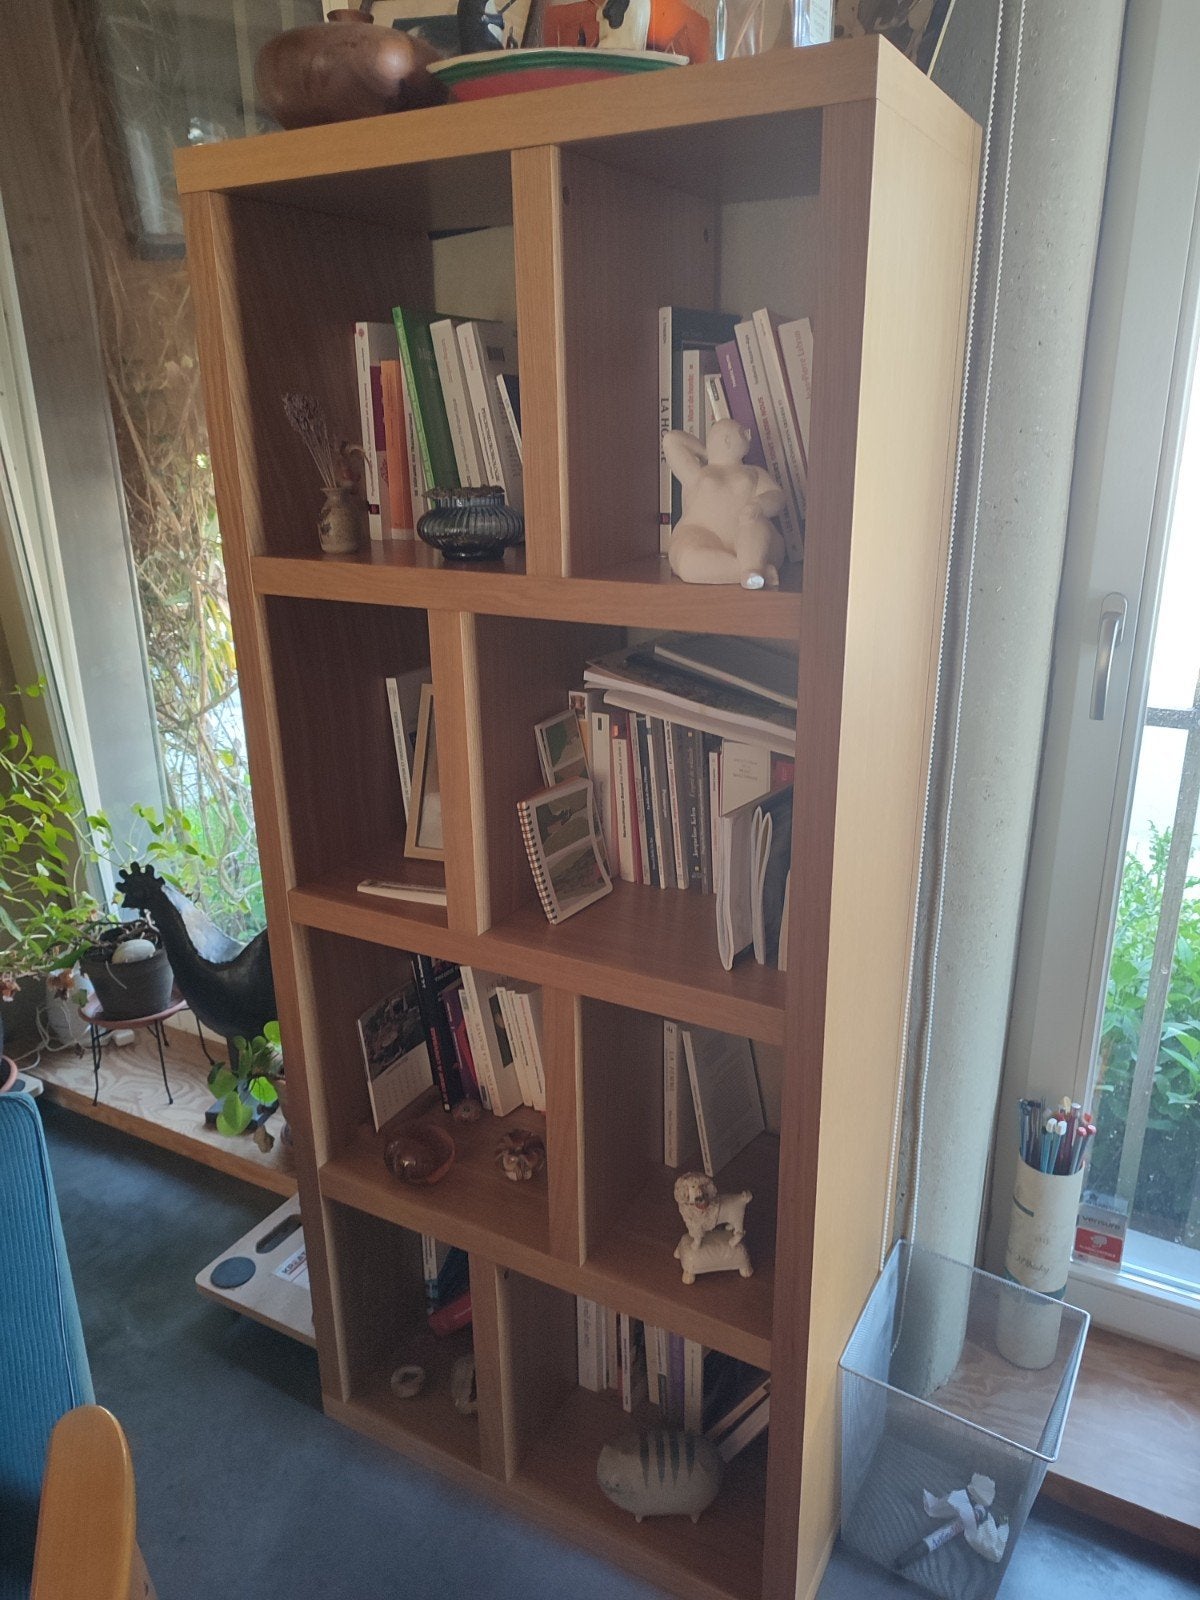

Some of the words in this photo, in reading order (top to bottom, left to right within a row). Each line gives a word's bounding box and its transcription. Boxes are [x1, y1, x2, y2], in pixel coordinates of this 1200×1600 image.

[660, 398, 668, 413] LA
[756, 396, 767, 416] NOUS
[691, 826, 699, 857] Jacqueline
[1082, 1215, 1121, 1230] verisure
